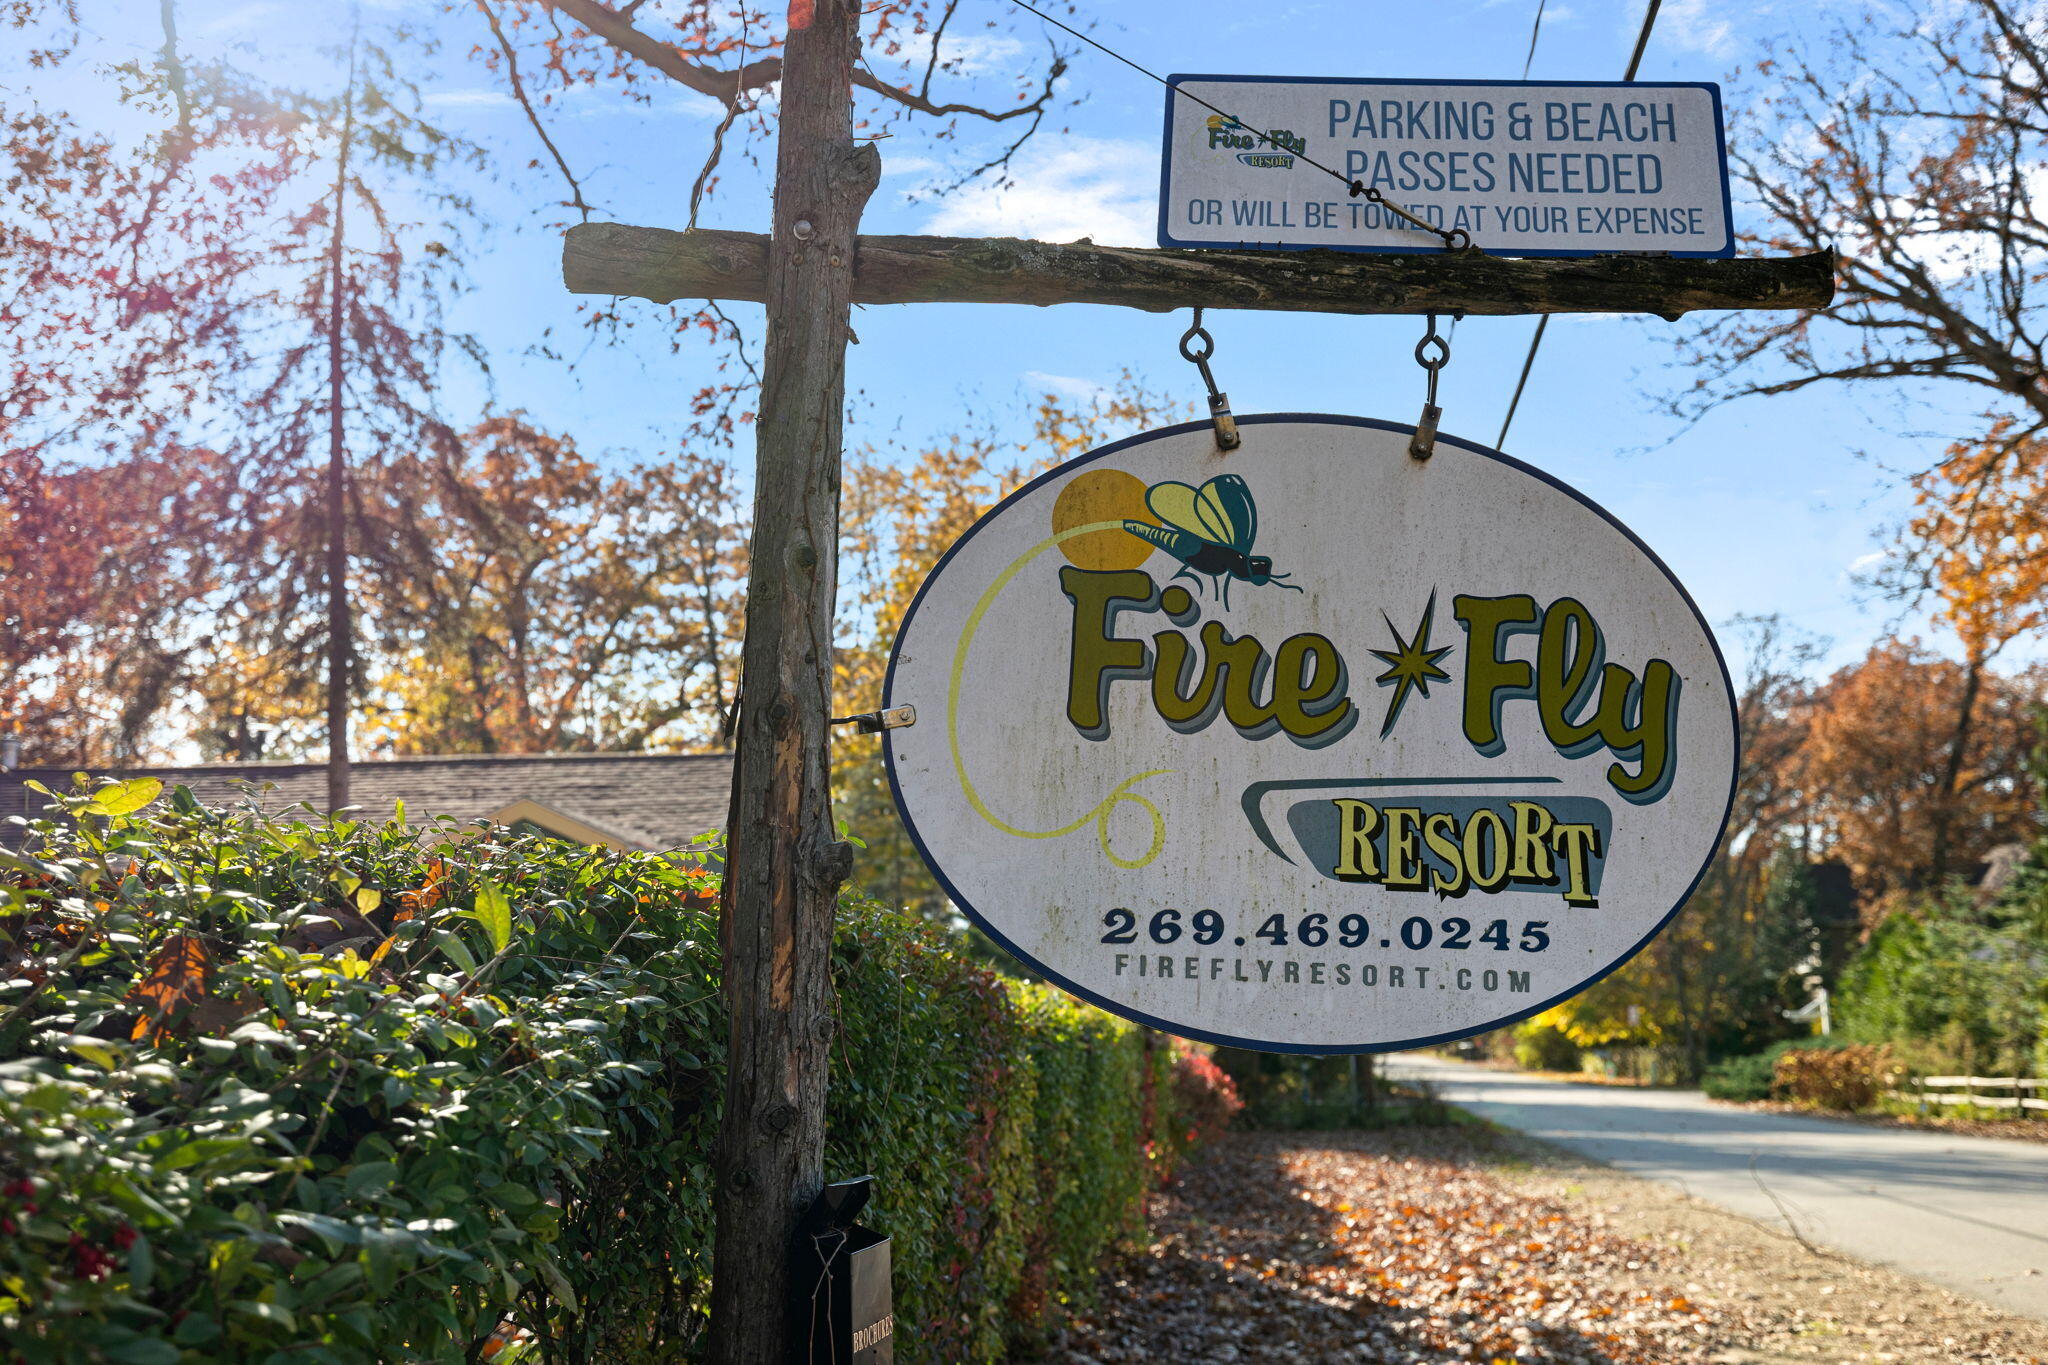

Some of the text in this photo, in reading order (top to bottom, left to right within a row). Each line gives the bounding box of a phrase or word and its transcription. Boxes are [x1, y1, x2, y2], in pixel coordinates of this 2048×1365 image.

[1207, 126, 1307, 156] Fire Fly
[1328, 99, 1677, 142] PARKING & BEACH
[1250, 155, 1294, 169] RESORT
[1346, 150, 1663, 194] PASSES NEEDED
[1188, 199, 1705, 235] OR WILL BE TOWED AT YOUR EXPENSE
[1058, 565, 1682, 806] Fire Fly
[1332, 797, 1603, 909] RESORT
[1100, 907, 1551, 953] 269.469.0245
[1115, 953, 1531, 993] FIREFLYRESORT.COM
[853, 1313, 894, 1354] BROCHURES
